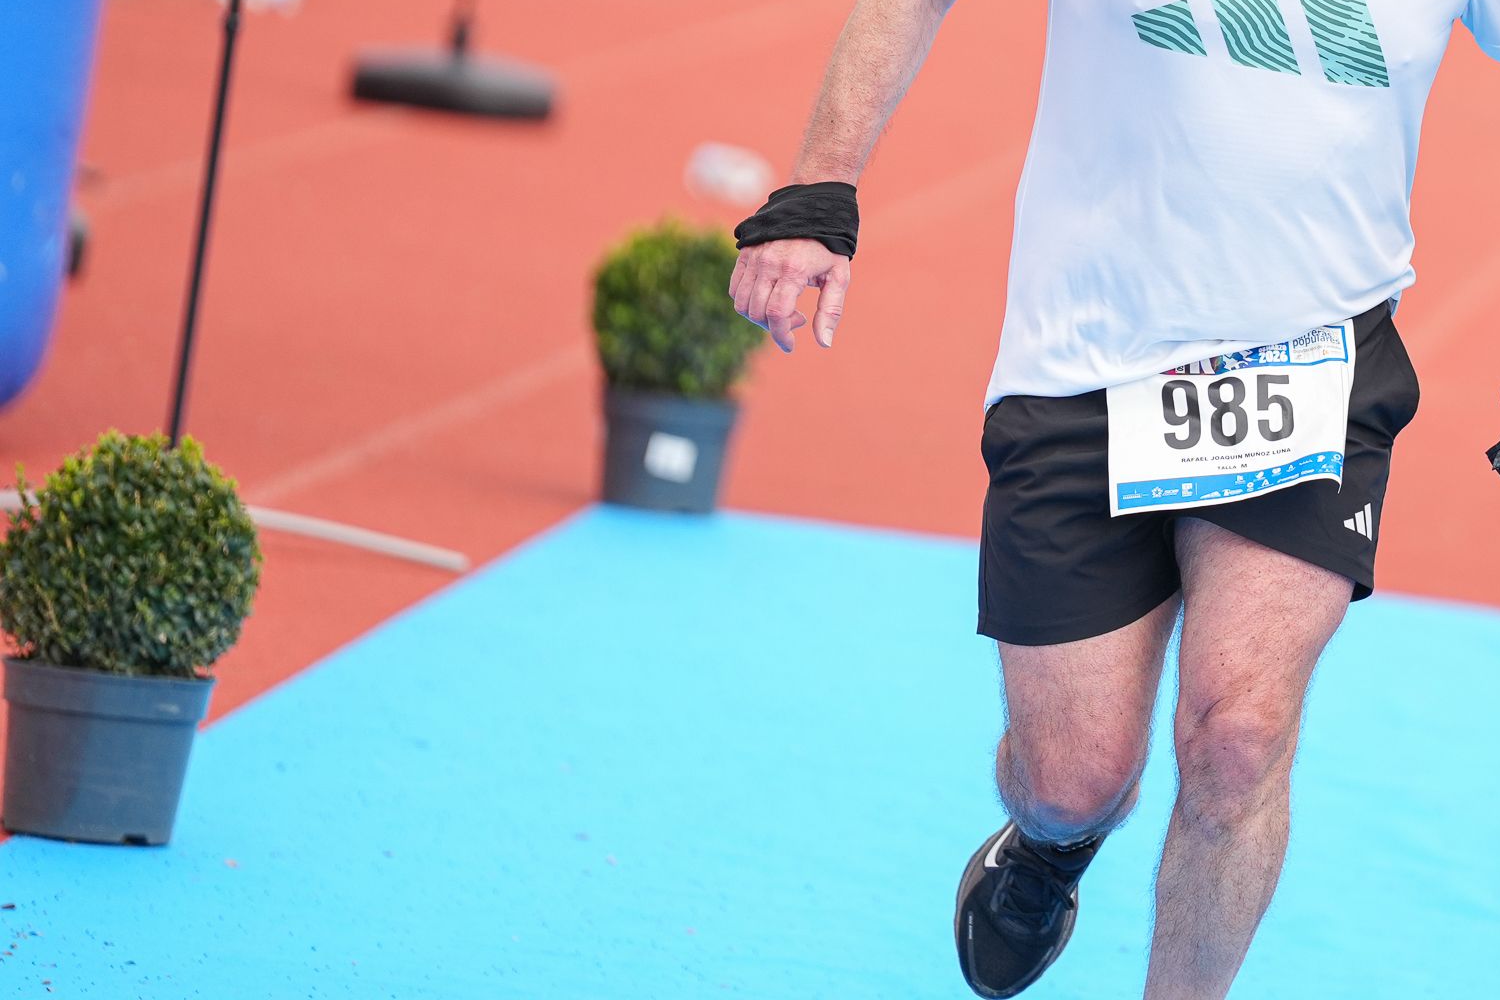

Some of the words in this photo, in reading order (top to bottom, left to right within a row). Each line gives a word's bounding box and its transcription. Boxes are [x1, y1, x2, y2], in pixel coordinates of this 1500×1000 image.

[1258, 350, 1288, 364] 2026
[1161, 373, 1295, 450] 985
[1272, 447, 1291, 455] LUNA
